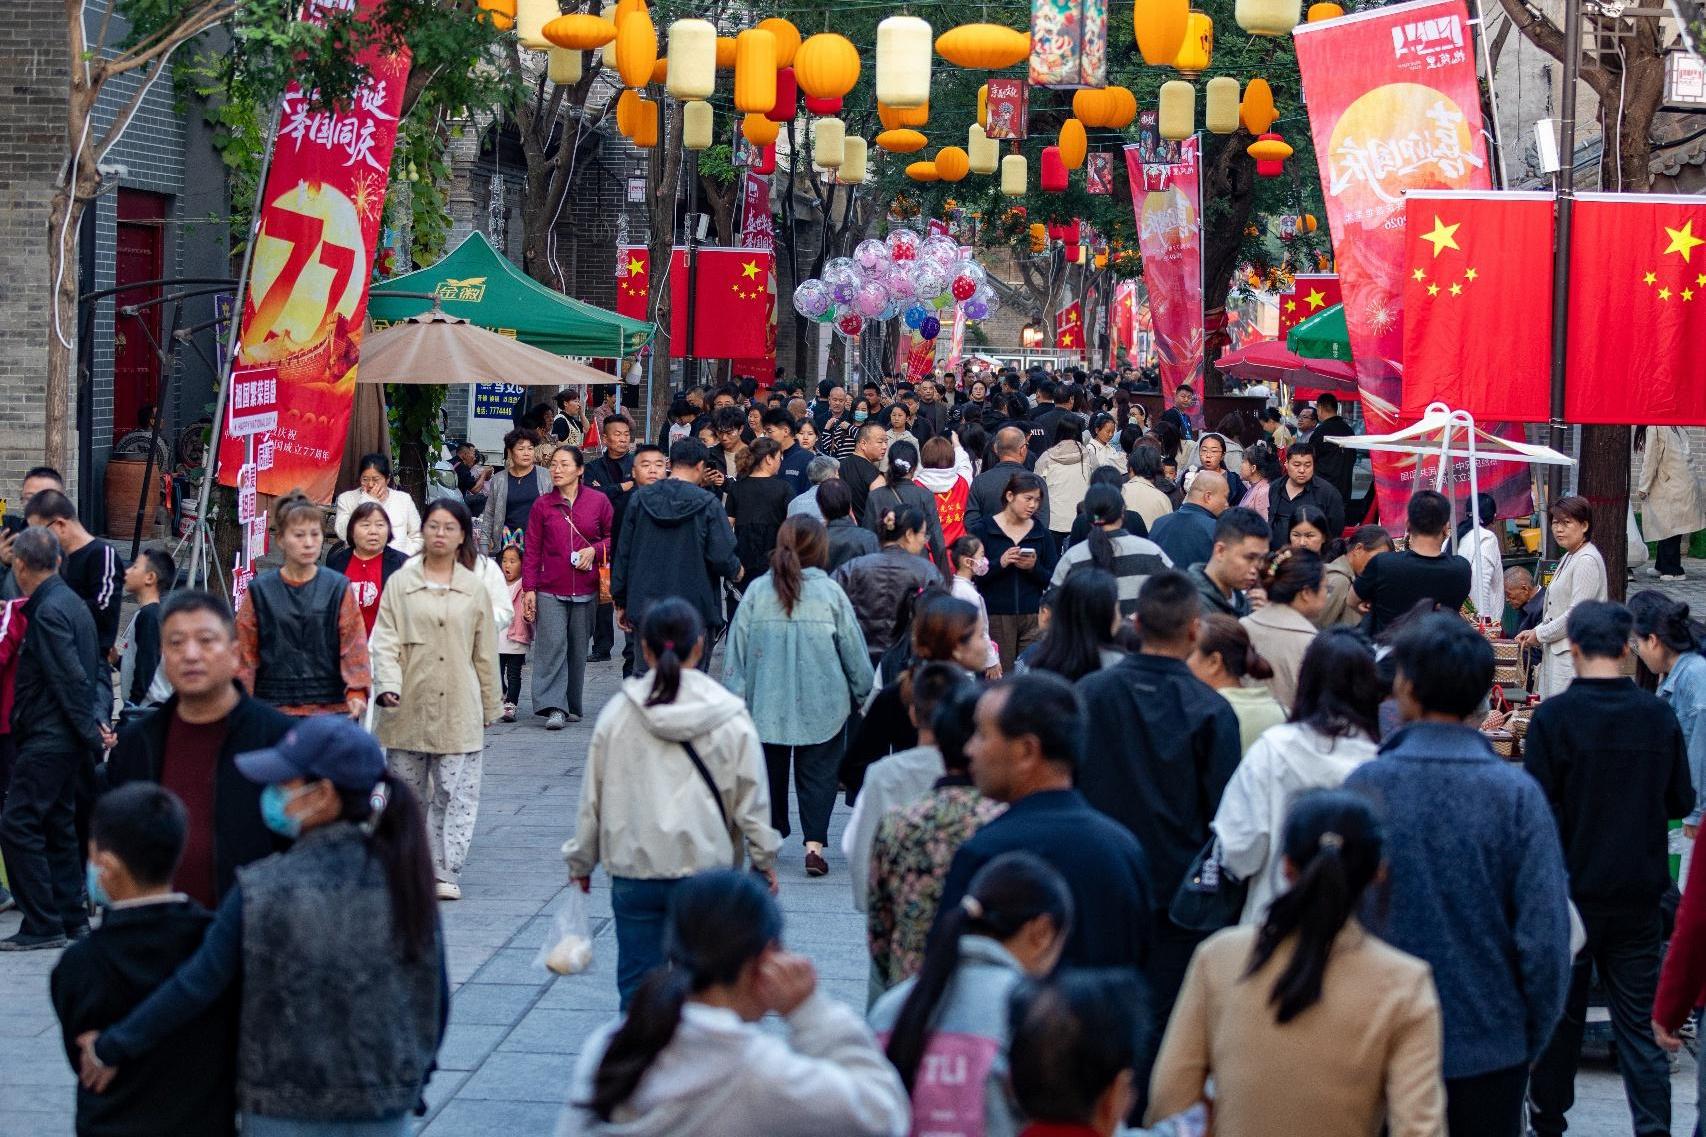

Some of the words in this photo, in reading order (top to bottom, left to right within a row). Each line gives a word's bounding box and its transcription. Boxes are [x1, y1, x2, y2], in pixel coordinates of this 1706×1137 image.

[279, 103, 388, 174] 举国同庆
[439, 286, 480, 300] 金徽
[235, 378, 276, 409] 祖国繁荣昌盛
